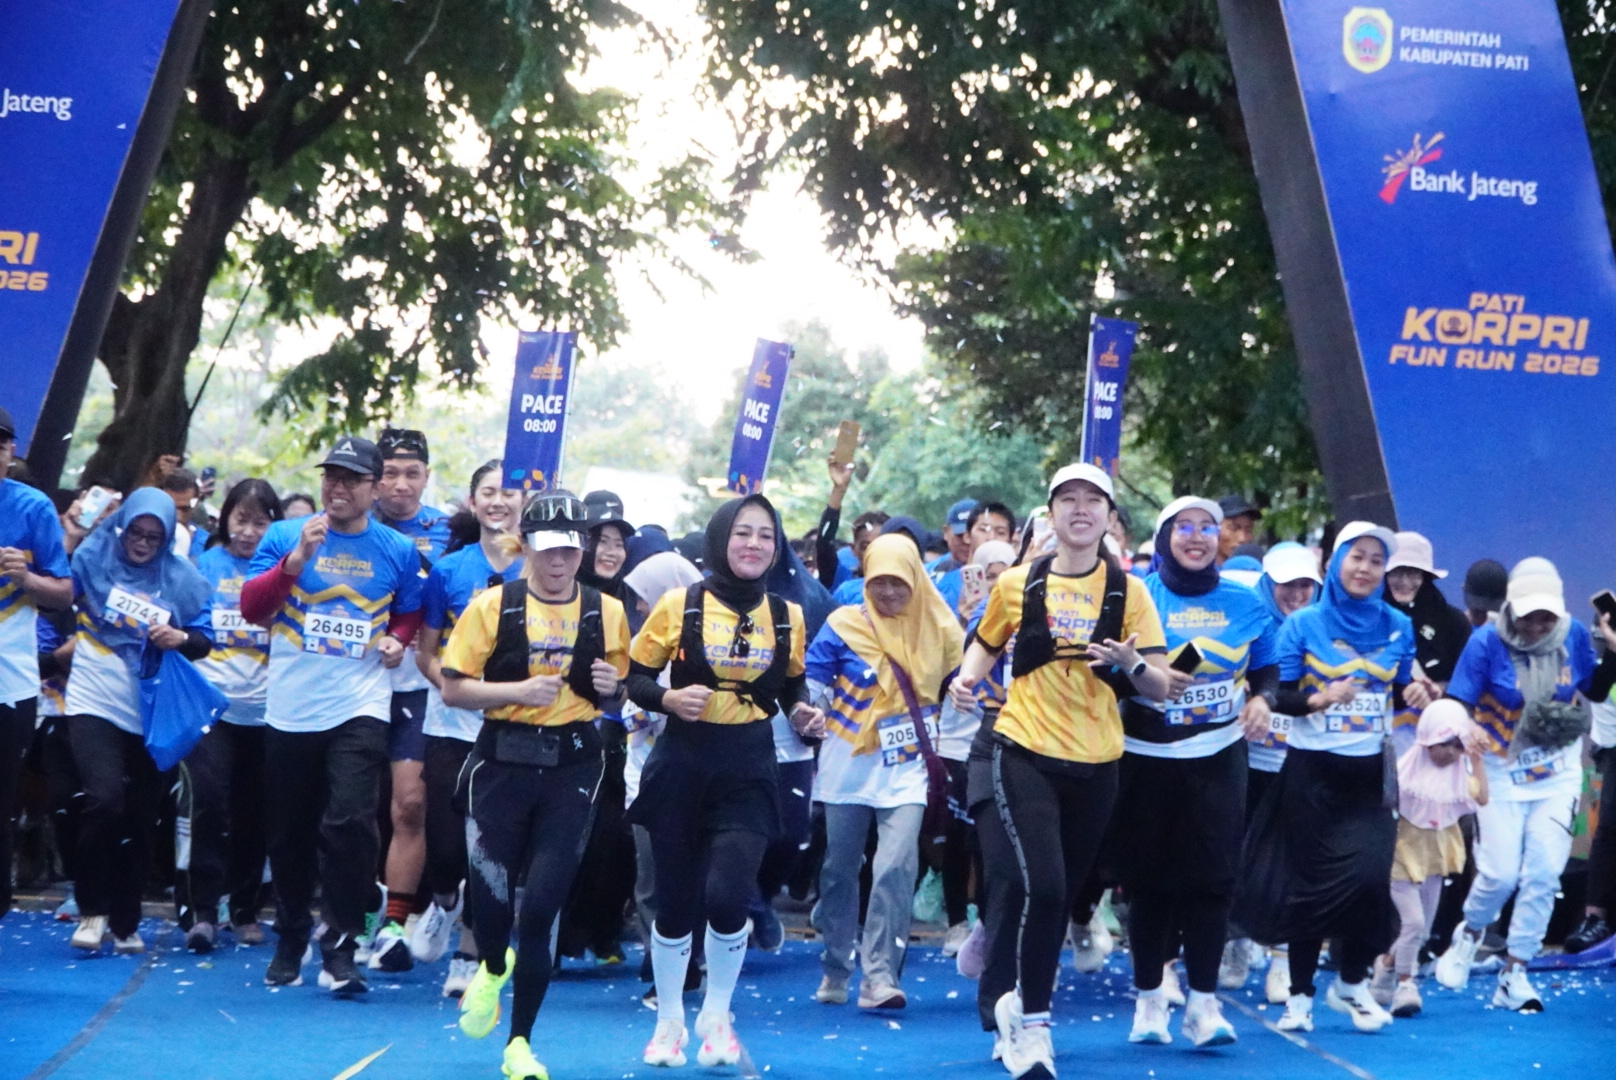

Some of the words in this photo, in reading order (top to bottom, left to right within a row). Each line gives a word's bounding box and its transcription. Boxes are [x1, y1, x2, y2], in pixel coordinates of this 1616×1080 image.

[1401, 26, 1501, 48] PEMERINTAH
[1400, 48, 1492, 69] KABUPATEN
[1495, 55, 1529, 71] PATI
[0, 88, 73, 121] Jateng
[1410, 167, 1465, 194] Bank
[1468, 171, 1538, 205] Jateng
[1469, 292, 1525, 313] PATI
[1402, 306, 1589, 350] KORPRI
[1389, 344, 1447, 367] FUN
[1455, 348, 1516, 371] RUN
[1524, 352, 1600, 376] 2026
[521, 394, 563, 414] PACE
[744, 398, 770, 423] PACE
[523, 418, 556, 433] 08:00
[116, 596, 159, 622] 21744
[221, 614, 254, 628] 217
[311, 618, 365, 640] 26495
[1173, 685, 1228, 705] 6530
[886, 722, 932, 746] 2050
